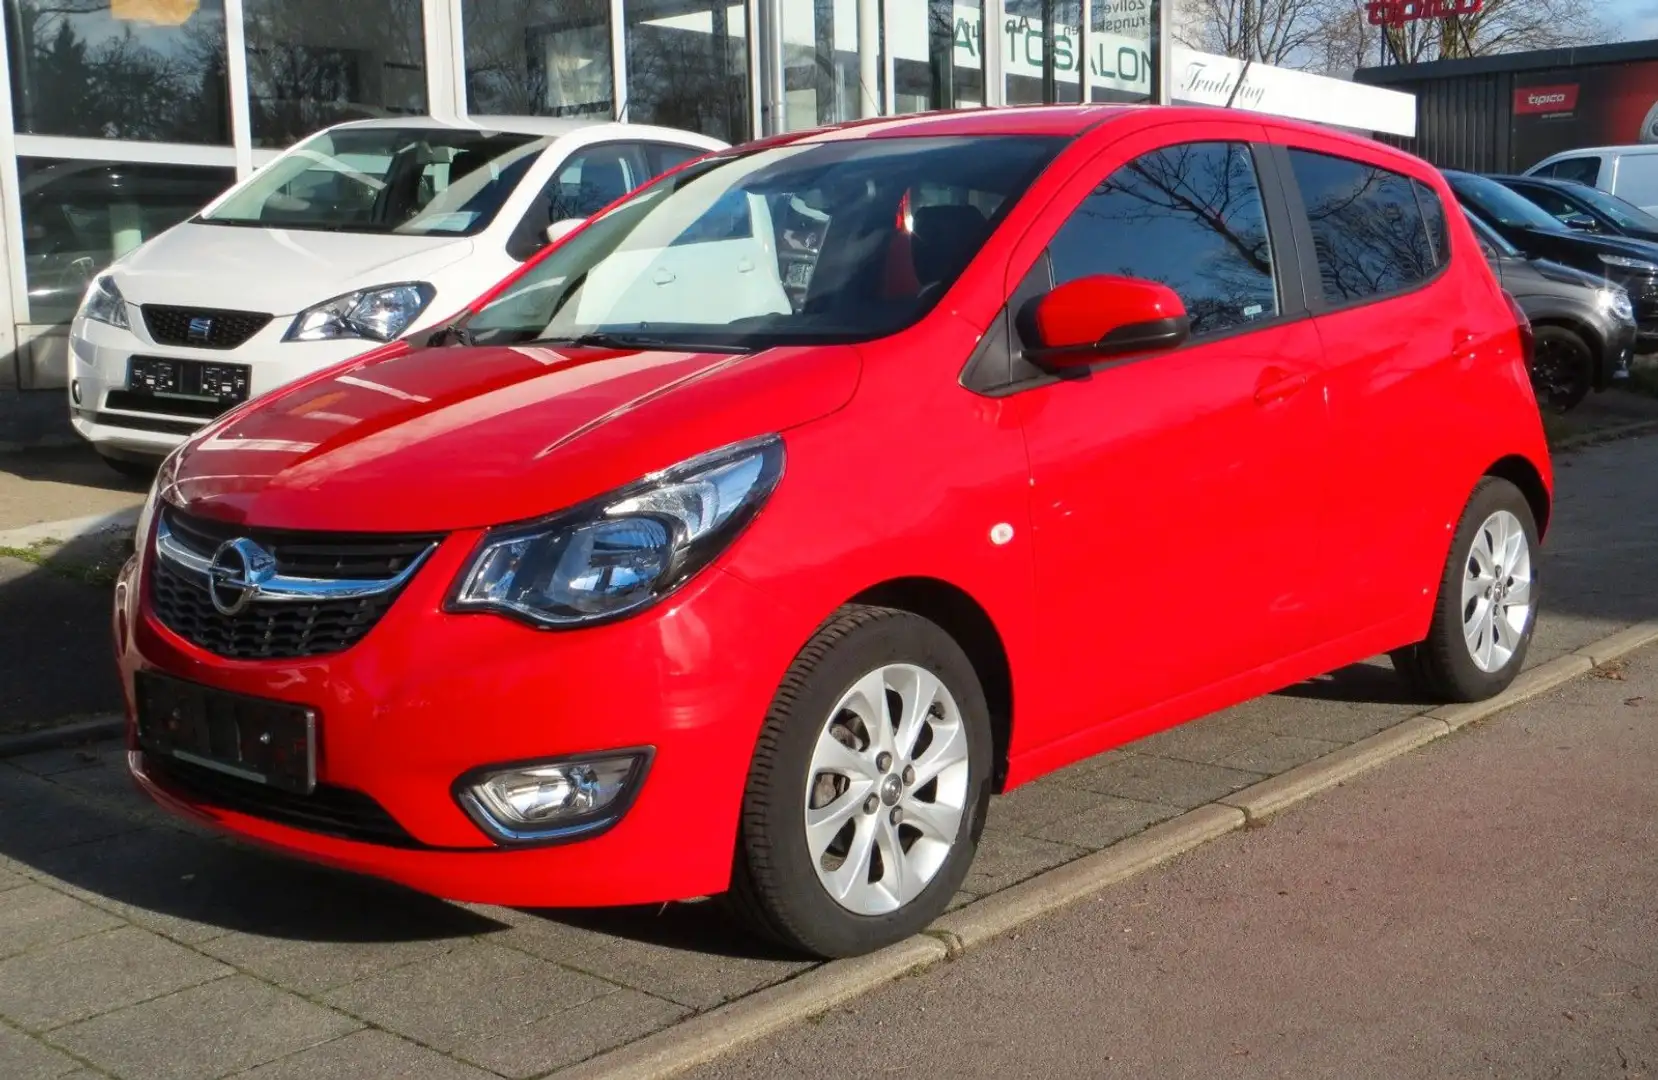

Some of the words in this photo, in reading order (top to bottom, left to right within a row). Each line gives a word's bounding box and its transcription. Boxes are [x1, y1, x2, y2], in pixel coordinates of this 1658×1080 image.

[954, 17, 1151, 83] ATOSLON
[1181, 62, 1265, 108] Trudeing
[1528, 93, 1566, 106] tipico
